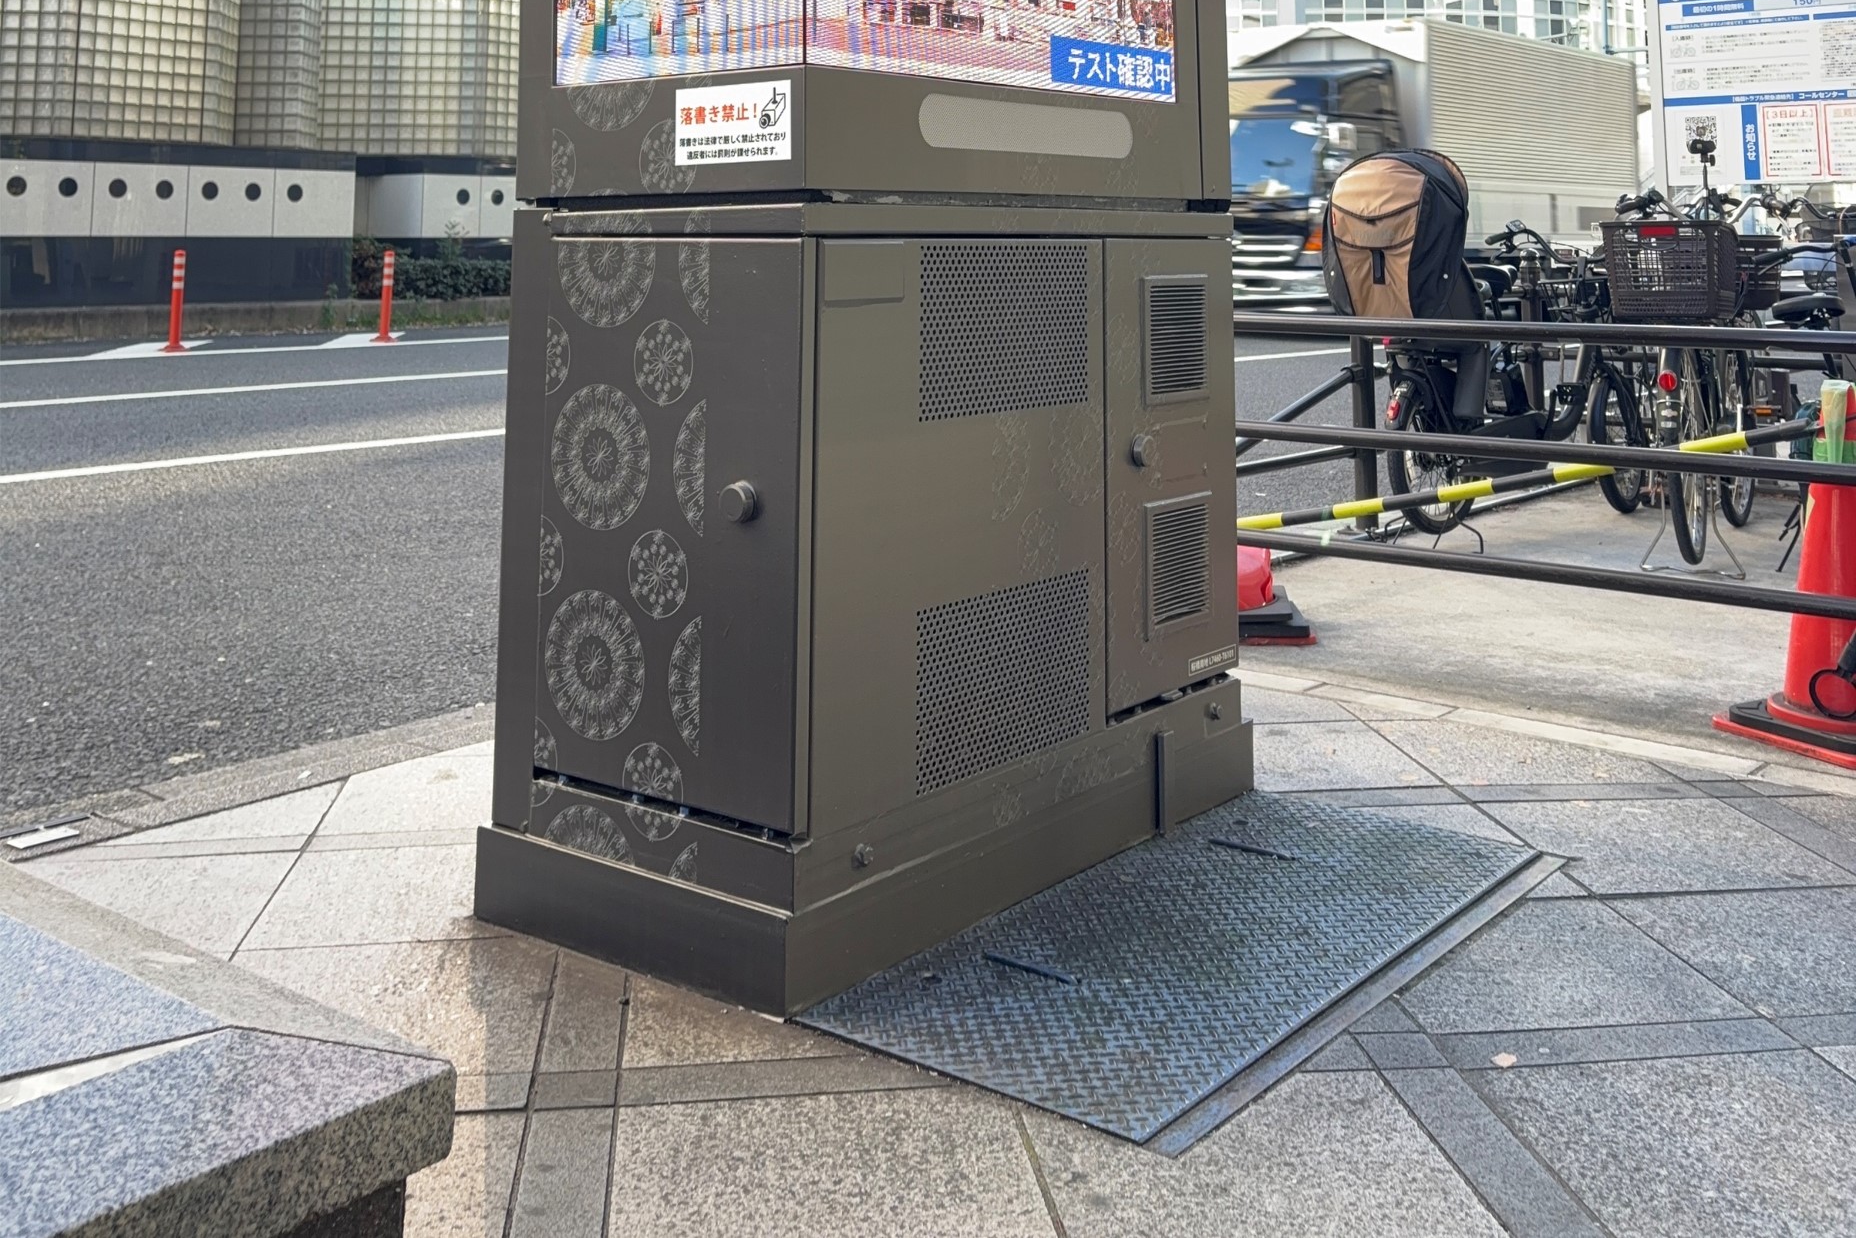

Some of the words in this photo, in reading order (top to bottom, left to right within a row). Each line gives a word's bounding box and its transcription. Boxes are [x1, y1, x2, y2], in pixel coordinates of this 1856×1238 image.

[1067, 48, 1170, 91] テスト確認中
[1798, 91, 1845, 100] コールセンター
[679, 131, 786, 147] 落書きは法律で厳しく禁止されており
[1745, 123, 1757, 161] お知らせ
[687, 146, 778, 160] 違反者には罰則が課せられます。
